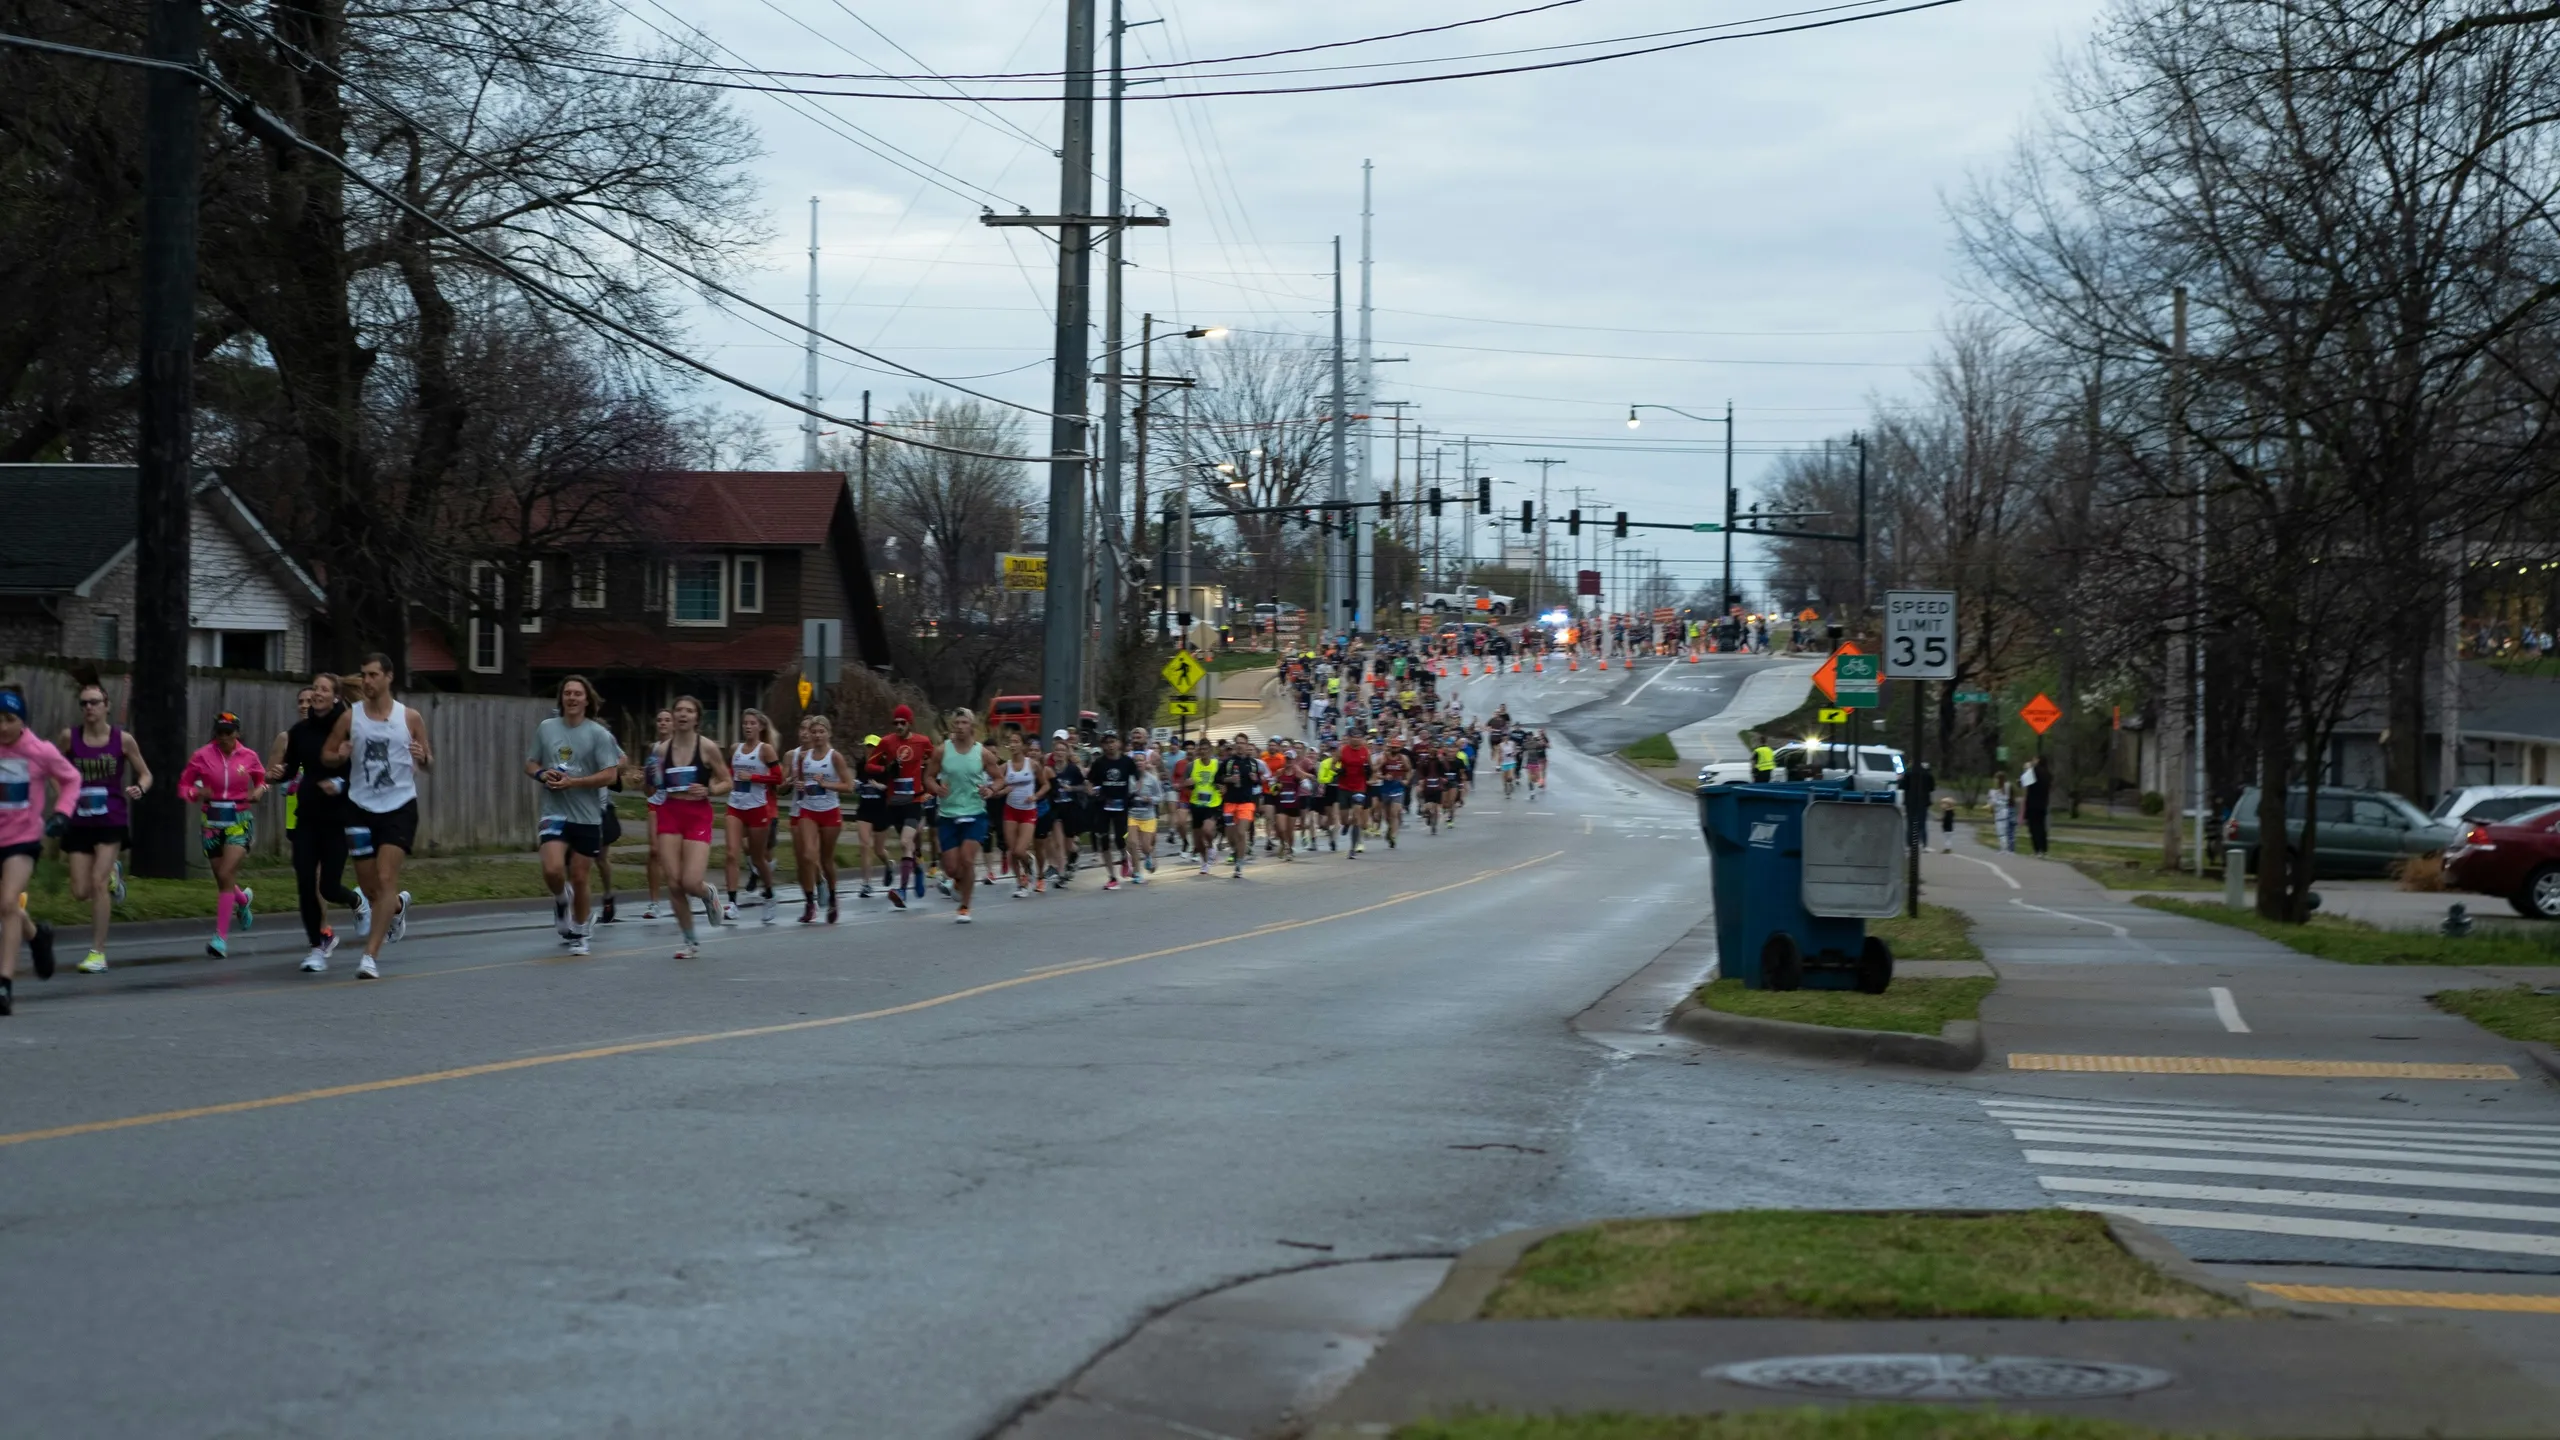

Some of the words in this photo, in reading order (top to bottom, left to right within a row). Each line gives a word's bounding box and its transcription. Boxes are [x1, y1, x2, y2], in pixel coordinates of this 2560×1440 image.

[1891, 601, 1950, 614] SPEED
[1897, 619, 1944, 631] LIMIT
[1892, 636, 1947, 667] 35
[1660, 685, 1721, 693] ONLY
